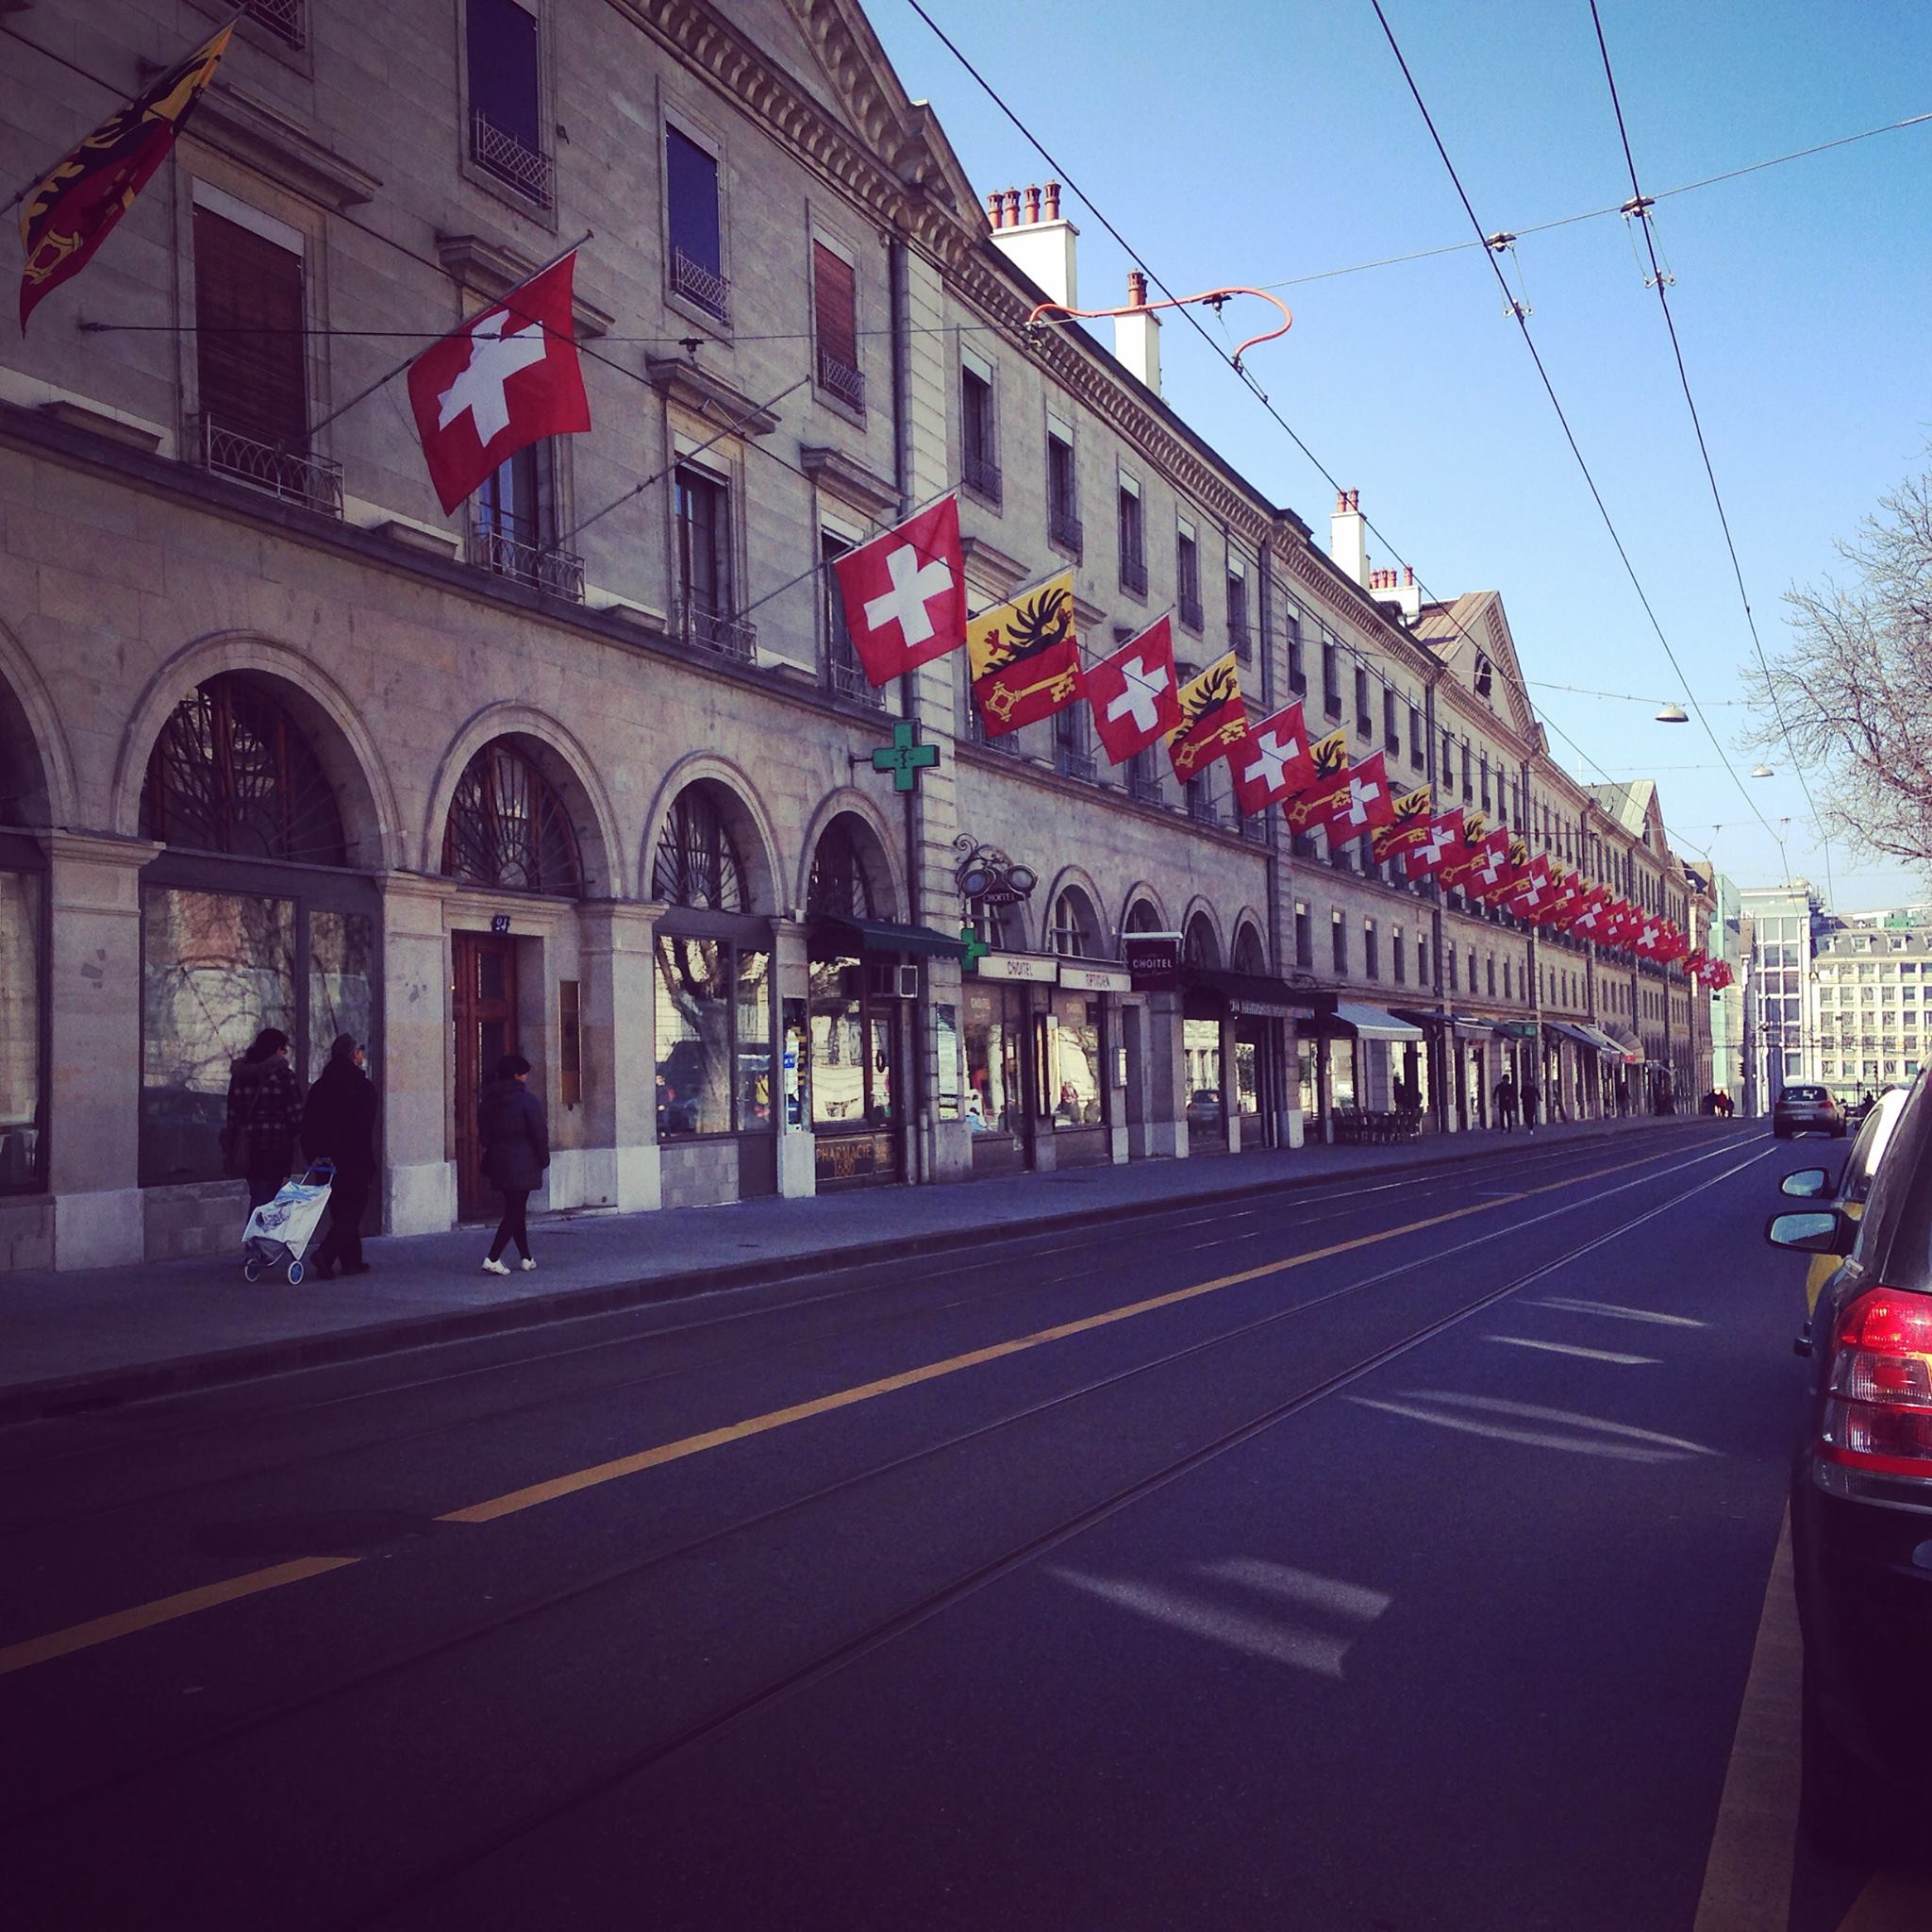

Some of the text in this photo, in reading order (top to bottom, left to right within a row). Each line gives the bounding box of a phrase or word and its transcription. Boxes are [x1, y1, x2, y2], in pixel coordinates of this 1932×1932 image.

[1007, 960, 1033, 976] CHOITEL
[1132, 958, 1173, 969] CHOITEL
[815, 1143, 874, 1163] PHARMACIE
